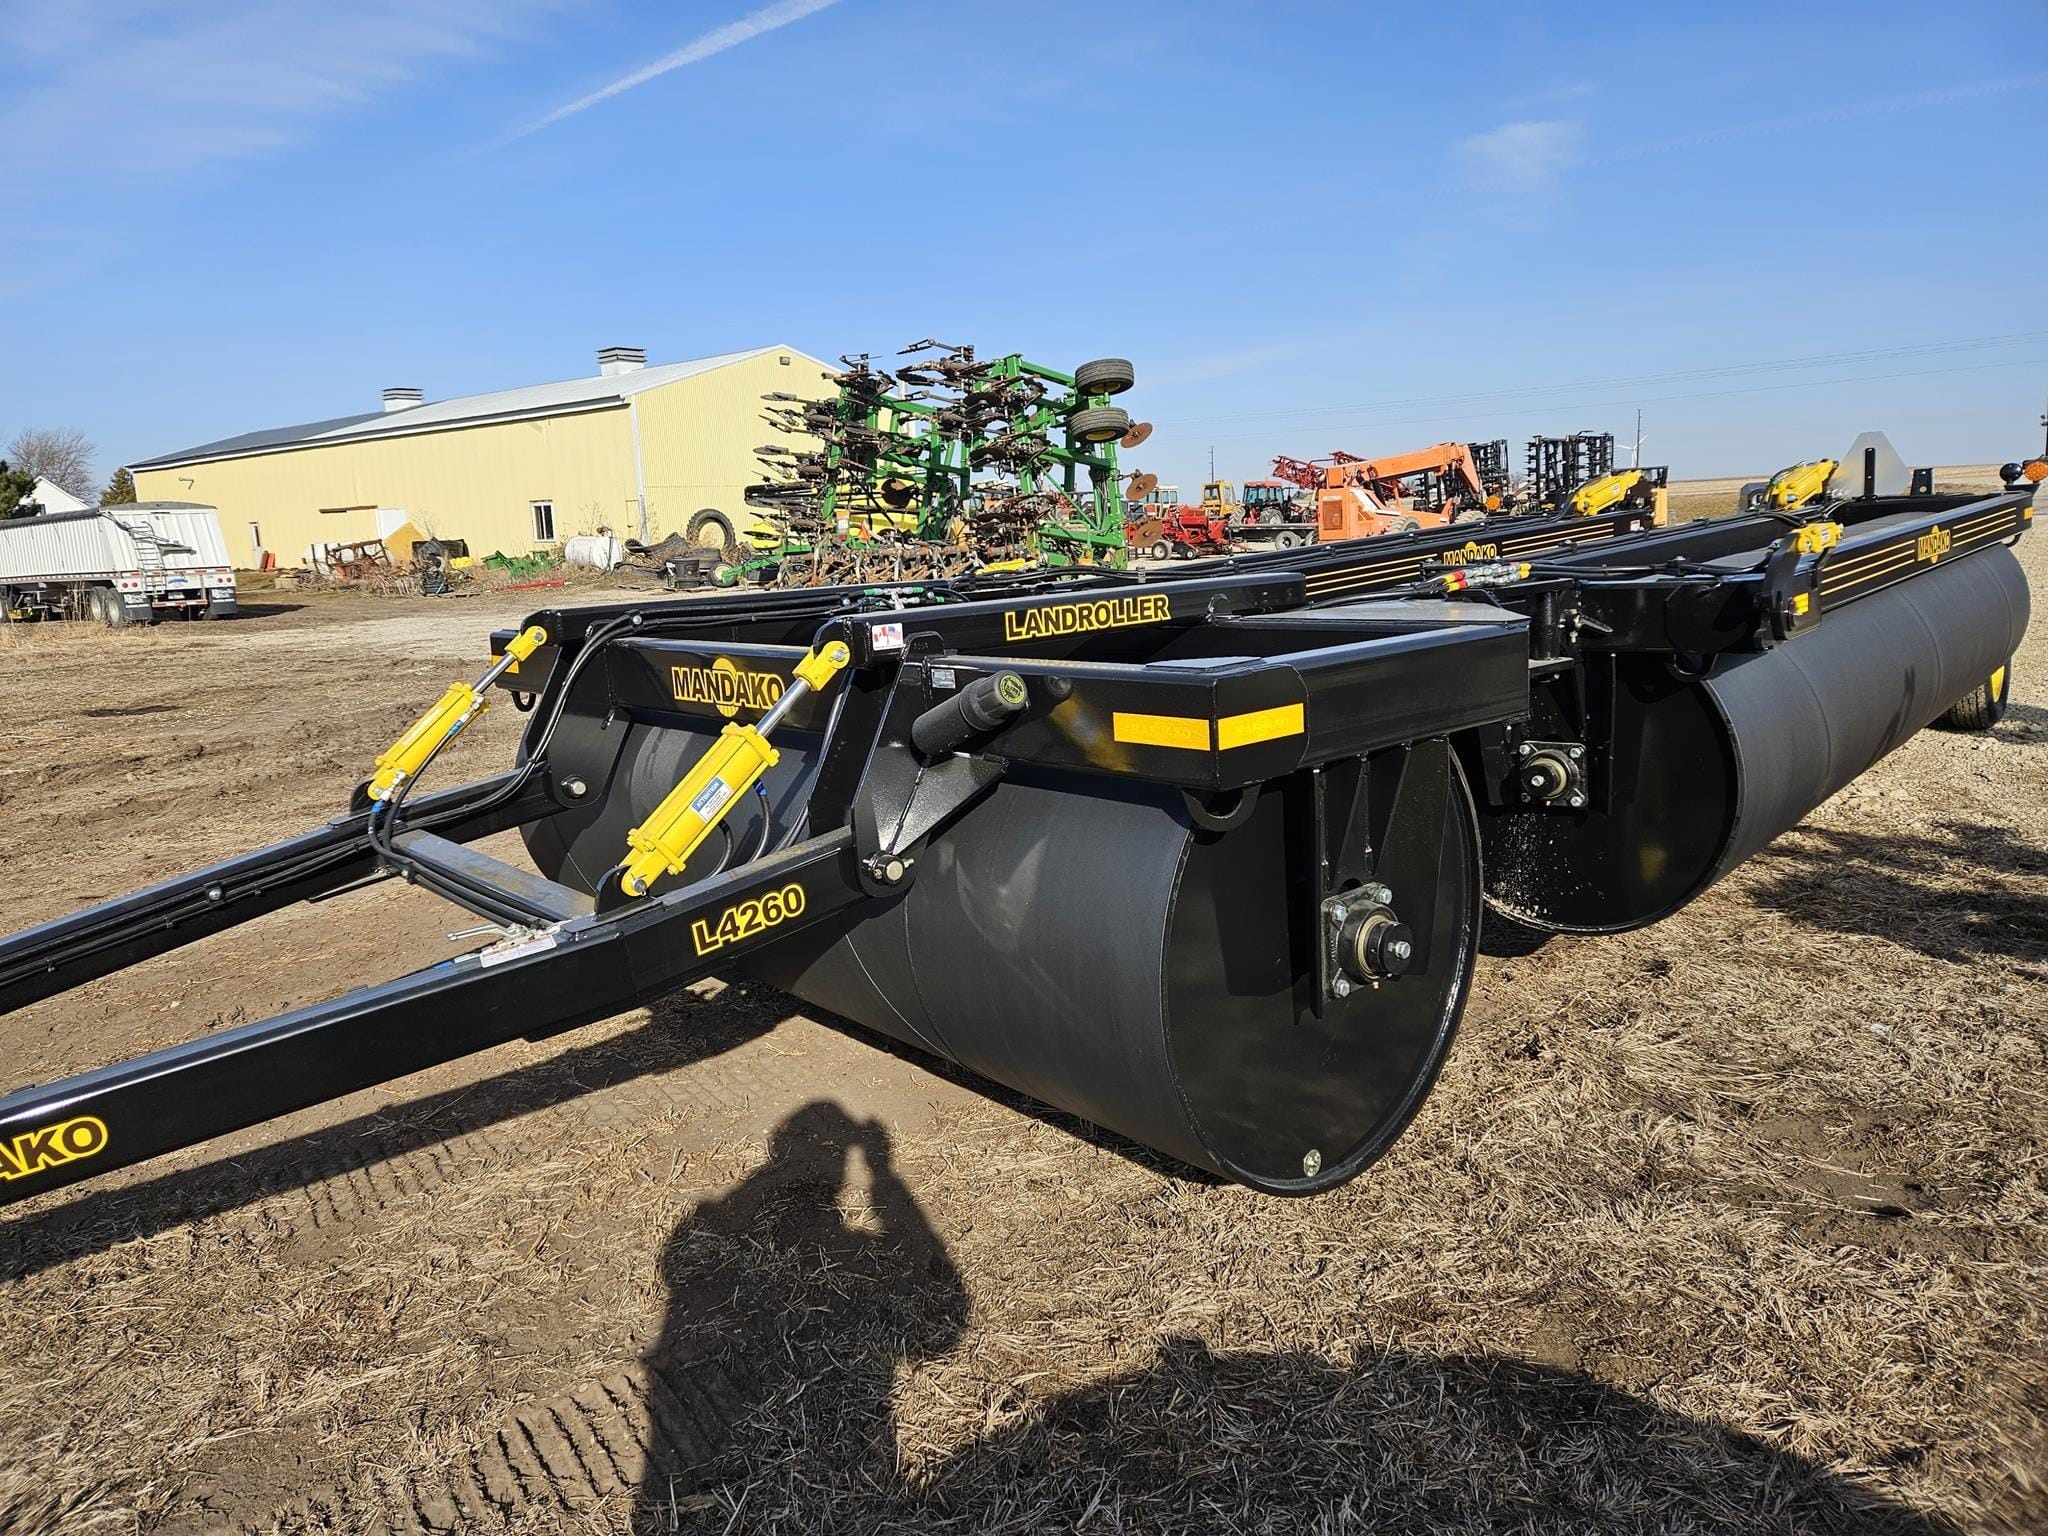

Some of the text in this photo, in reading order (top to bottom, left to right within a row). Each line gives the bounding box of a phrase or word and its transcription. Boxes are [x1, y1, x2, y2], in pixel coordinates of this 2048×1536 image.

[1443, 543, 1498, 566] MANDAKO
[1917, 529, 1950, 561] MANDAKO
[1005, 594, 1171, 641] LANDROLLER
[671, 666, 785, 710] MANDAKO
[696, 781, 720, 808] ATTENTION
[691, 884, 805, 956] L4260
